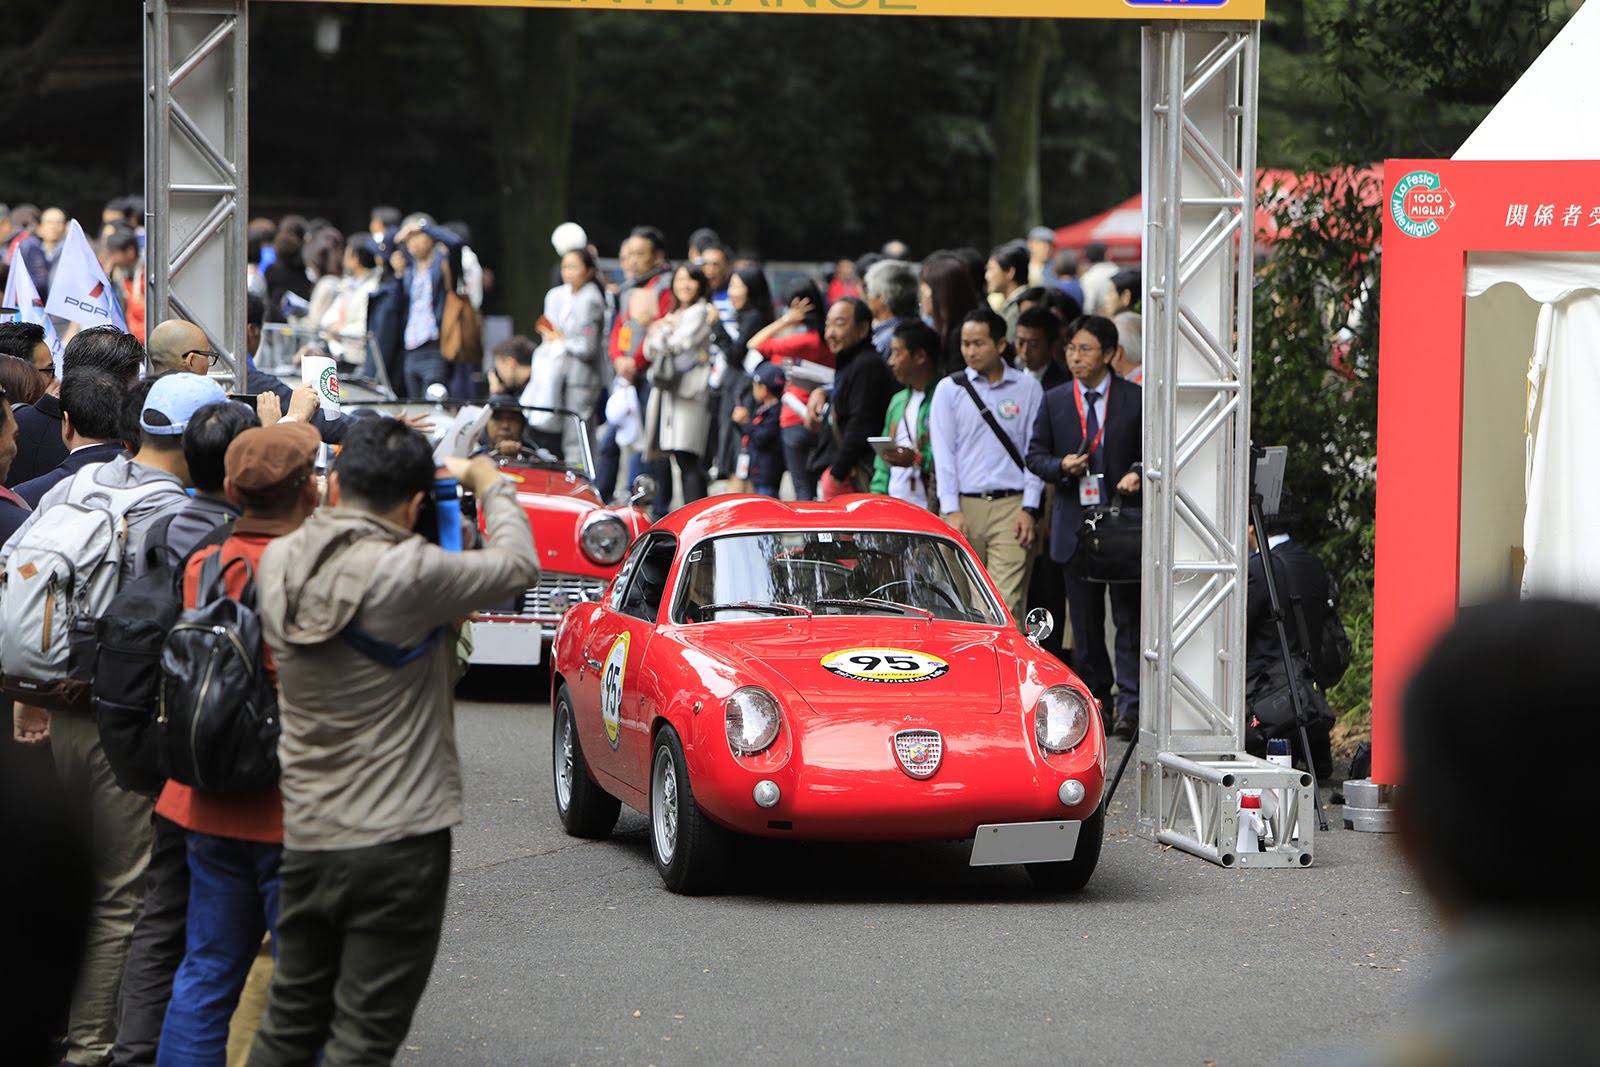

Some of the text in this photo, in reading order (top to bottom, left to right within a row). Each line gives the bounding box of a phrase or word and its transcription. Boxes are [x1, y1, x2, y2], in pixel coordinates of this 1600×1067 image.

[1395, 173, 1434, 198] La Festa
[1413, 194, 1442, 203] 1000
[1393, 199, 1437, 237] Mille Miglia
[1411, 205, 1444, 215] MIGLIA
[849, 655, 920, 671] 95
[605, 662, 620, 716] 95
